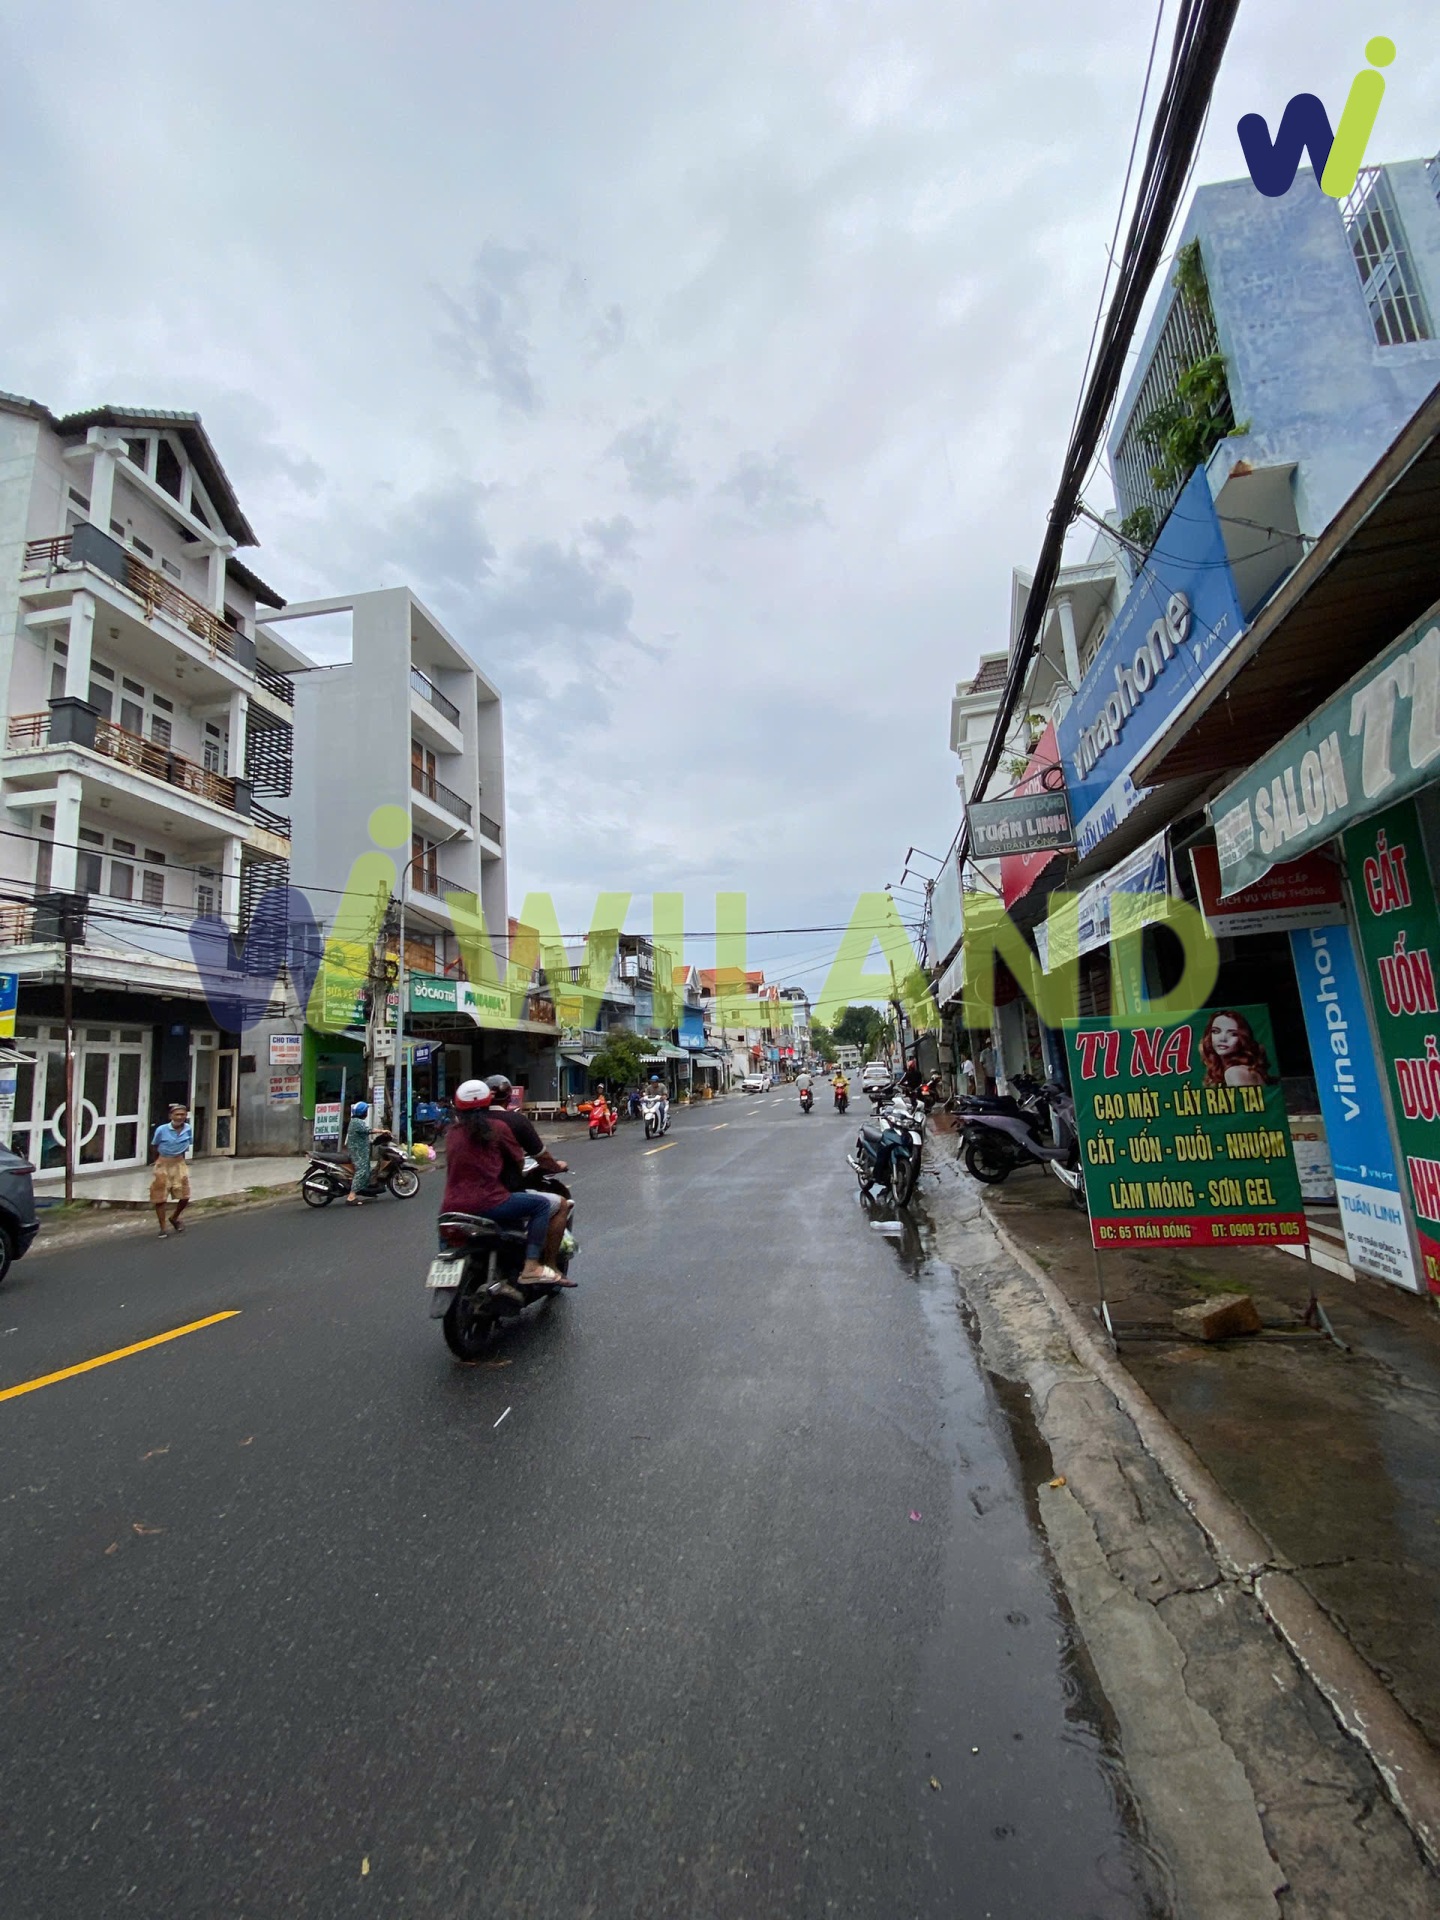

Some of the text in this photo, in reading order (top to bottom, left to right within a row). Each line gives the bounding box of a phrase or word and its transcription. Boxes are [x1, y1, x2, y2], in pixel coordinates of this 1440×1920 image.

[1203, 612, 1228, 651] VNPT
[1255, 731, 1348, 854] SALON
[975, 813, 1067, 843] TUẤN LINH
[1364, 828, 1412, 916] CẮT
[1377, 930, 1438, 1017] UỐN
[272, 1036, 285, 1044] CHO
[1130, 1025, 1192, 1077] NA
[1094, 1094, 1125, 1125] CẠO
[1127, 1087, 1160, 1123] MẶT
[1173, 1081, 1202, 1116] LẤY
[1205, 1083, 1236, 1115] RÁY
[1239, 1086, 1265, 1113] TAI
[1087, 1129, 1116, 1165] CẮT
[1128, 1128, 1163, 1164] UỐN
[1175, 1125, 1214, 1162] DUỖI
[1225, 1126, 1287, 1165] NHUỘM
[1110, 1177, 1145, 1209] LÀM
[1146, 1176, 1195, 1208] MÓNG
[1208, 1177, 1243, 1207] SƠN
[1245, 1178, 1277, 1206] GEL
[1368, 1169, 1393, 1181] VNPT
[1341, 1194, 1402, 1226] TUẤN LINH
[1099, 1225, 1117, 1240] ĐC:
[1119, 1225, 1131, 1239] 65
[1212, 1222, 1299, 1238] ĐT: 0909 276 005
